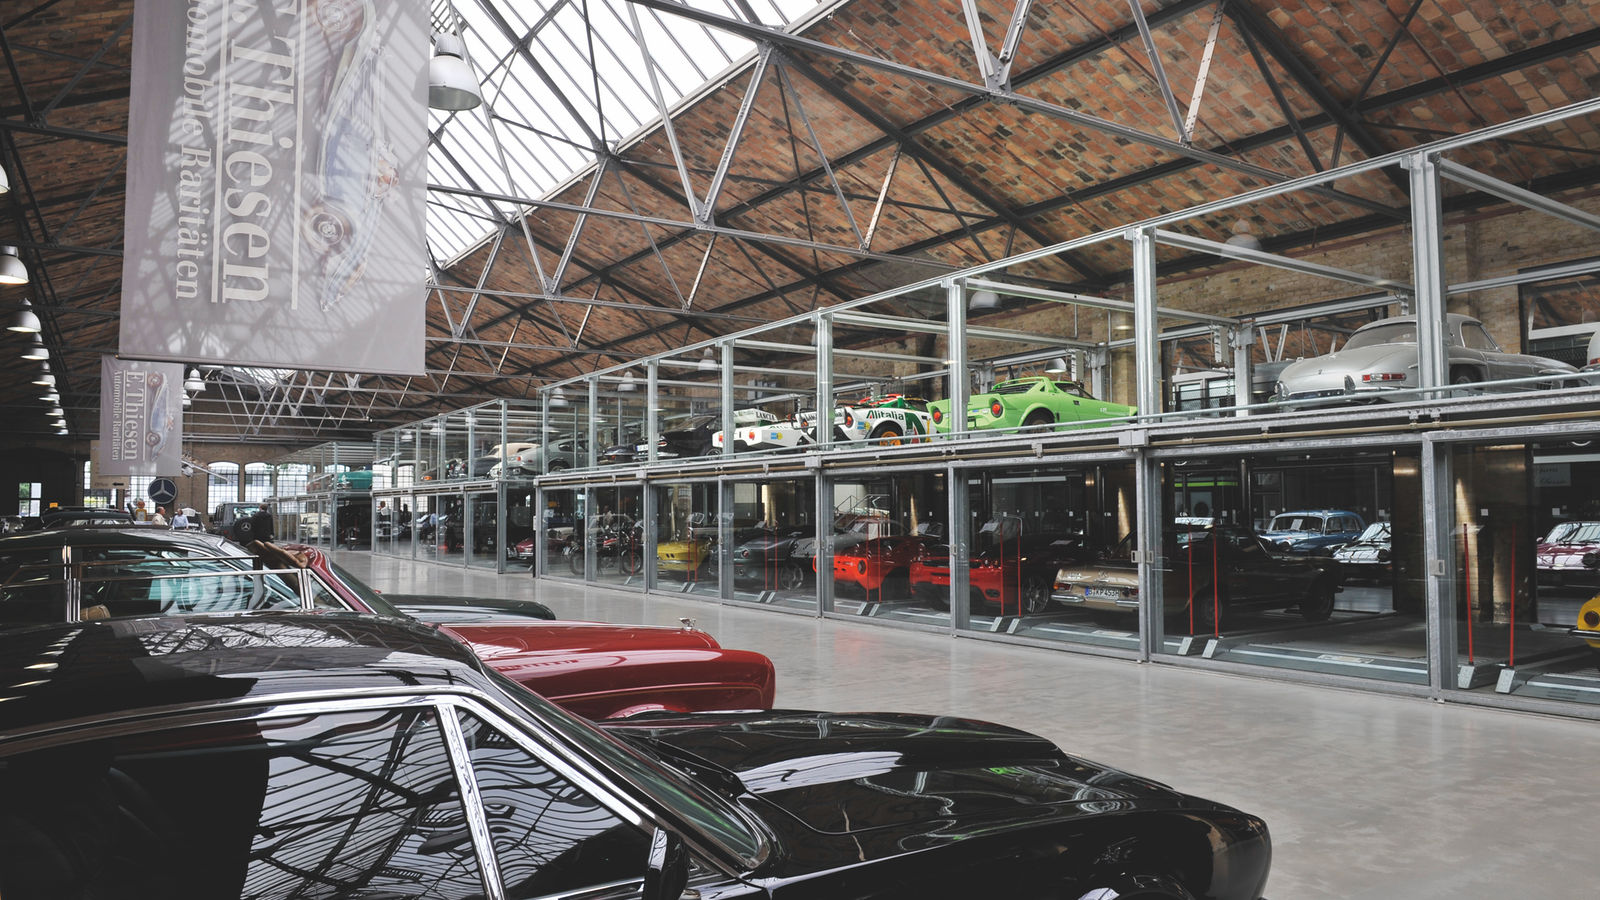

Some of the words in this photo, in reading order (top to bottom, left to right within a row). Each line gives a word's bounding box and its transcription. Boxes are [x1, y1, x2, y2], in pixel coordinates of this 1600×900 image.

[176, 145, 212, 299] Raritäten
[112, 370, 122, 418] Automobile
[755, 411, 775, 421] LANCIA
[866, 410, 904, 420] Alitalia
[111, 420, 121, 460] Raritäten
